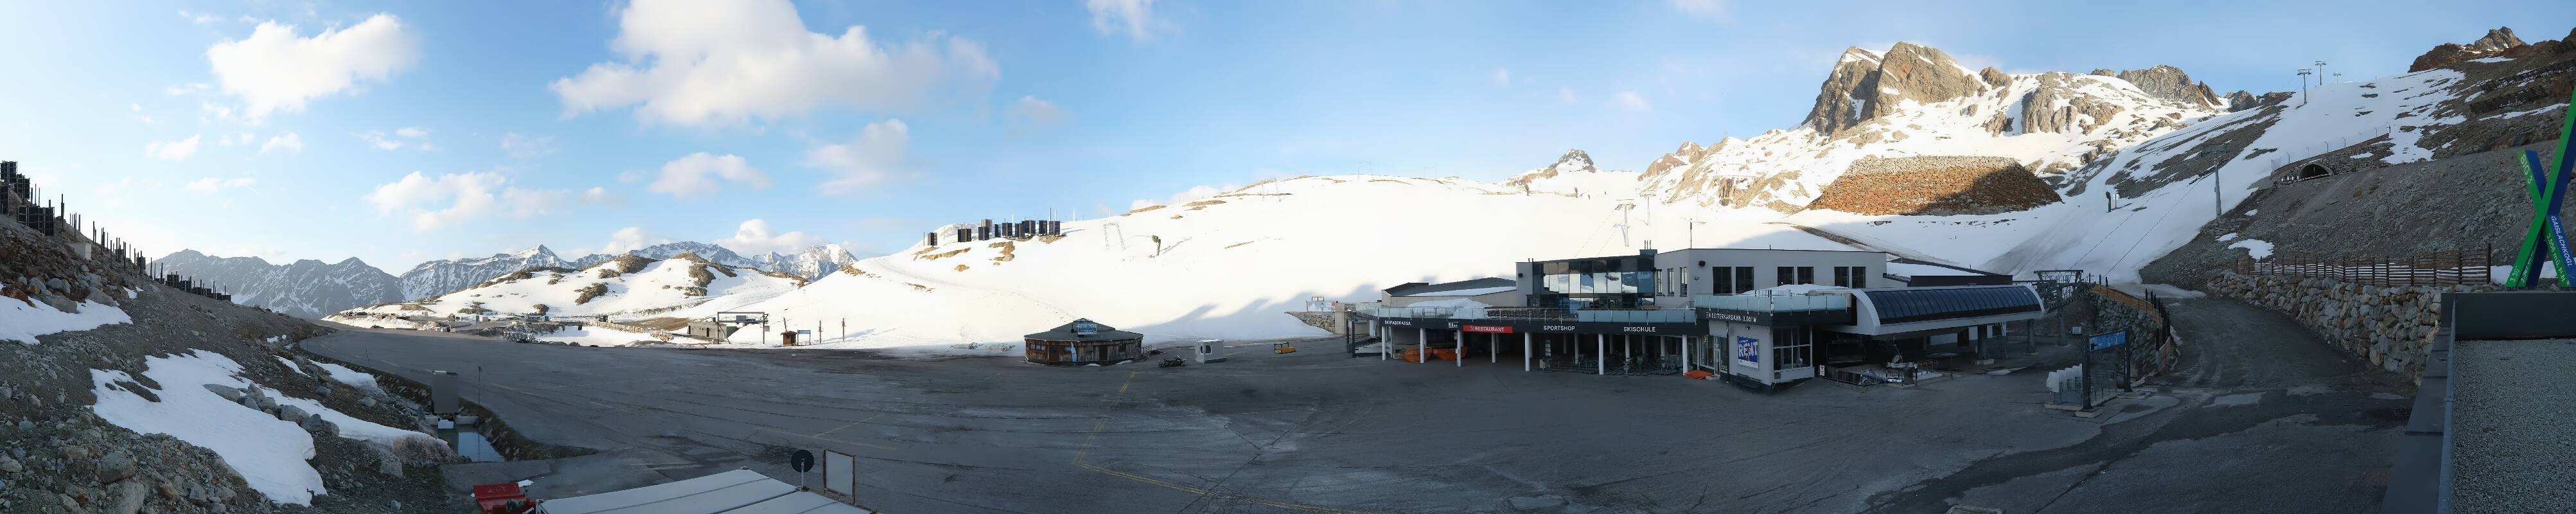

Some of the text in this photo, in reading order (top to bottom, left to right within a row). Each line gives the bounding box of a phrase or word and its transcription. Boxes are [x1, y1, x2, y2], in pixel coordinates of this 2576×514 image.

[2521, 154, 2532, 184] BIG 3
[2552, 216, 2572, 267] GAISLACHKOGL
[1738, 342, 1758, 357] RENT
